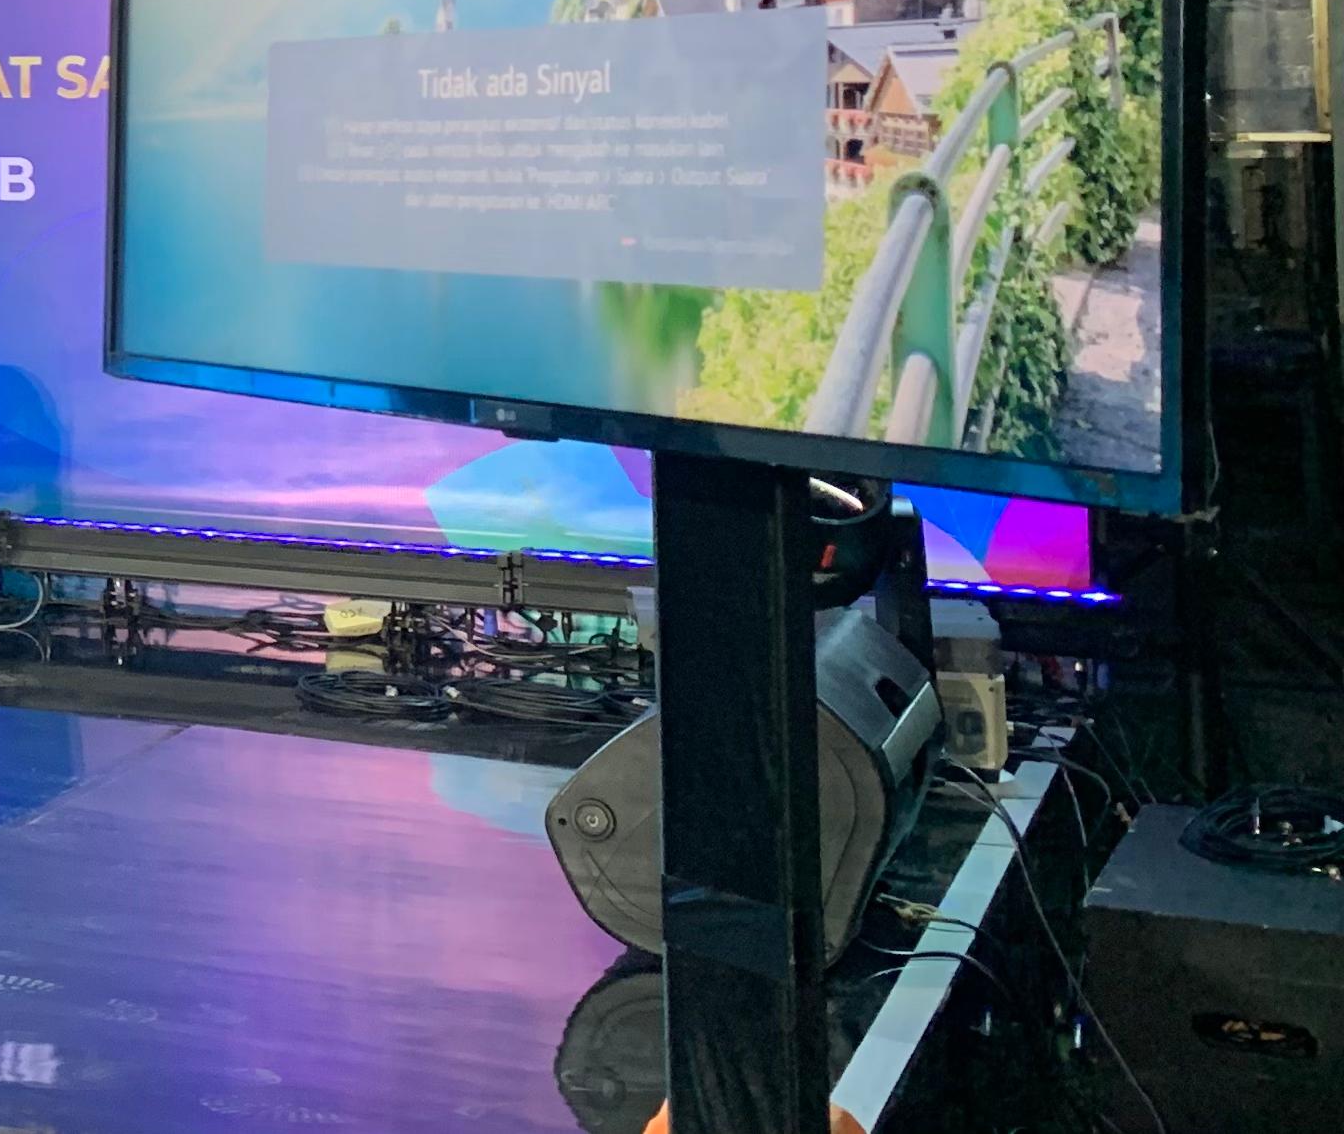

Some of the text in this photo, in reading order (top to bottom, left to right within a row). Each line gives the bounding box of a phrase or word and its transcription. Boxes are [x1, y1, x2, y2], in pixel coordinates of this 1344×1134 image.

[418, 60, 611, 103] Tidak ada Sinyal
